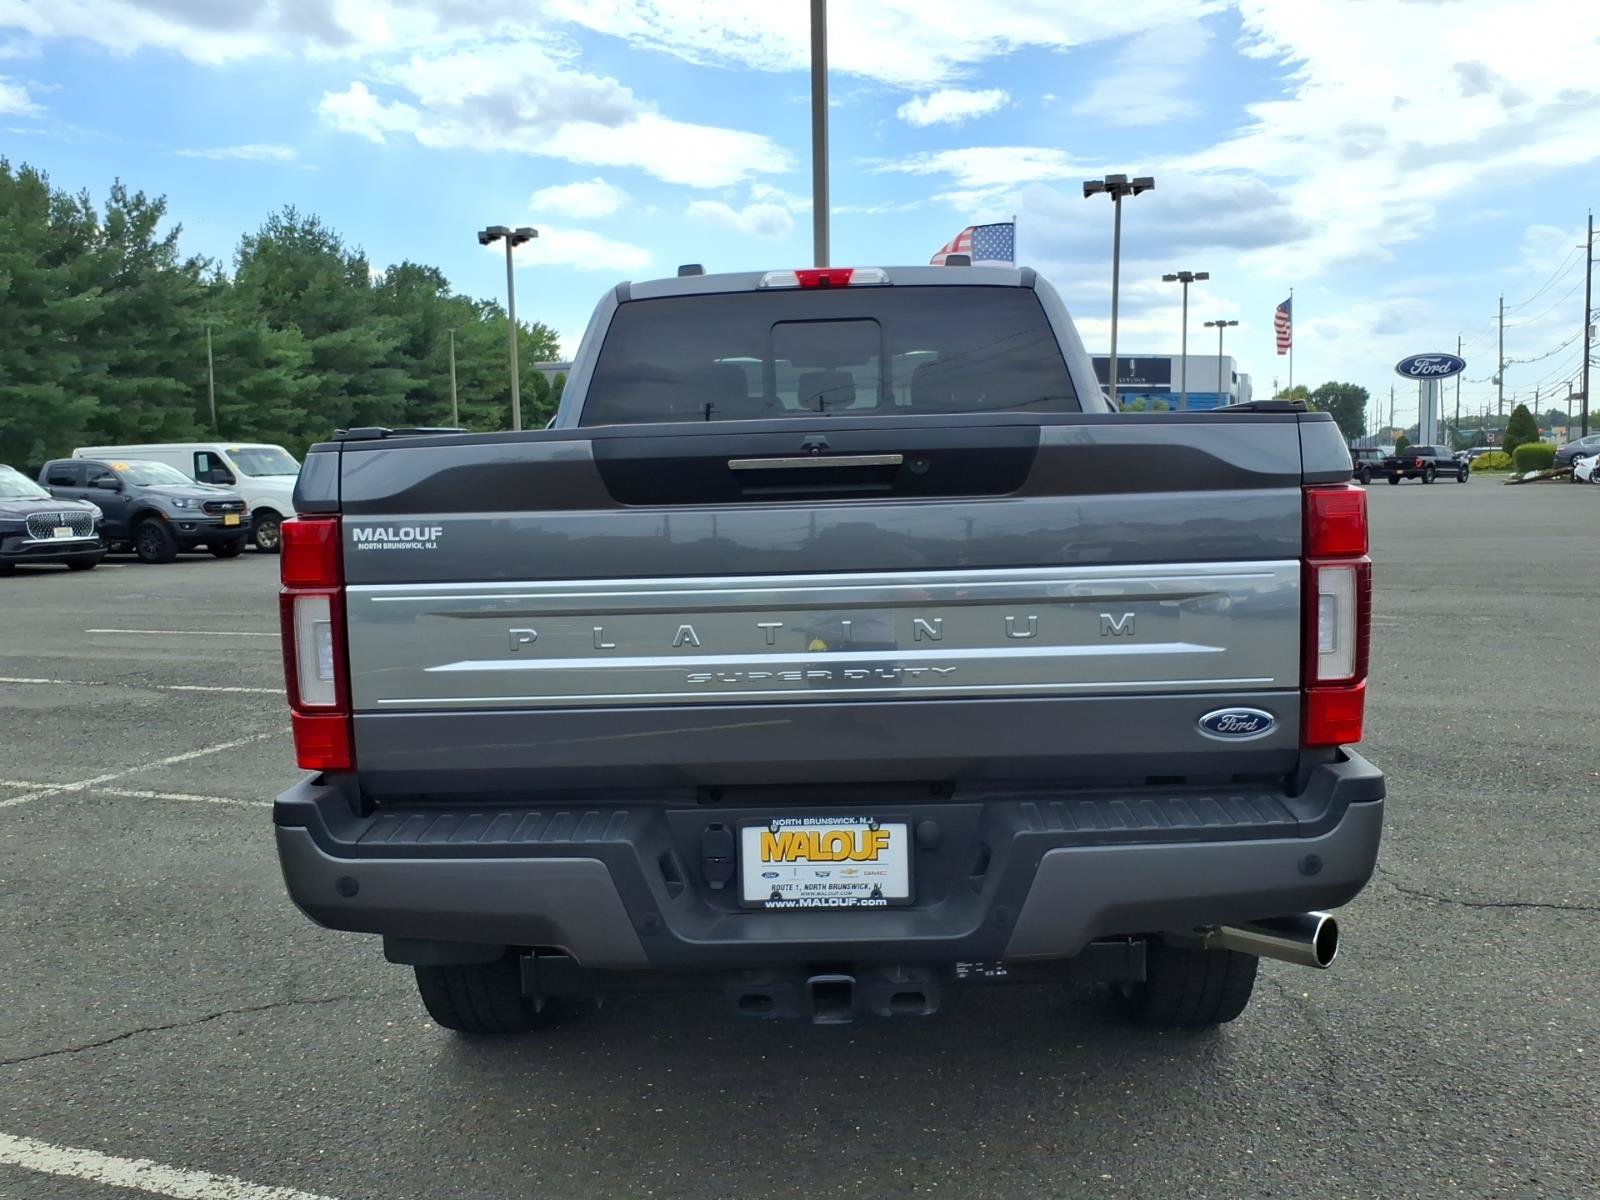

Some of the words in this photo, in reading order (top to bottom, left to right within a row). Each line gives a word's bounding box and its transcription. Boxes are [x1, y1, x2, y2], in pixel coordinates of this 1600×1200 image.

[1410, 358, 1452, 375] Ford
[352, 527, 443, 541] MALOUF
[358, 542, 382, 550] NORTH
[509, 612, 1136, 651] PLATINUM
[687, 669, 833, 684] SUPER
[843, 666, 957, 679] DUTY
[1217, 714, 1258, 731] Ford
[760, 830, 891, 862] MALOUF
[771, 883, 793, 891] ROUTE
[803, 883, 827, 891] NORTH
[765, 897, 888, 908] www.MALOUF.com
